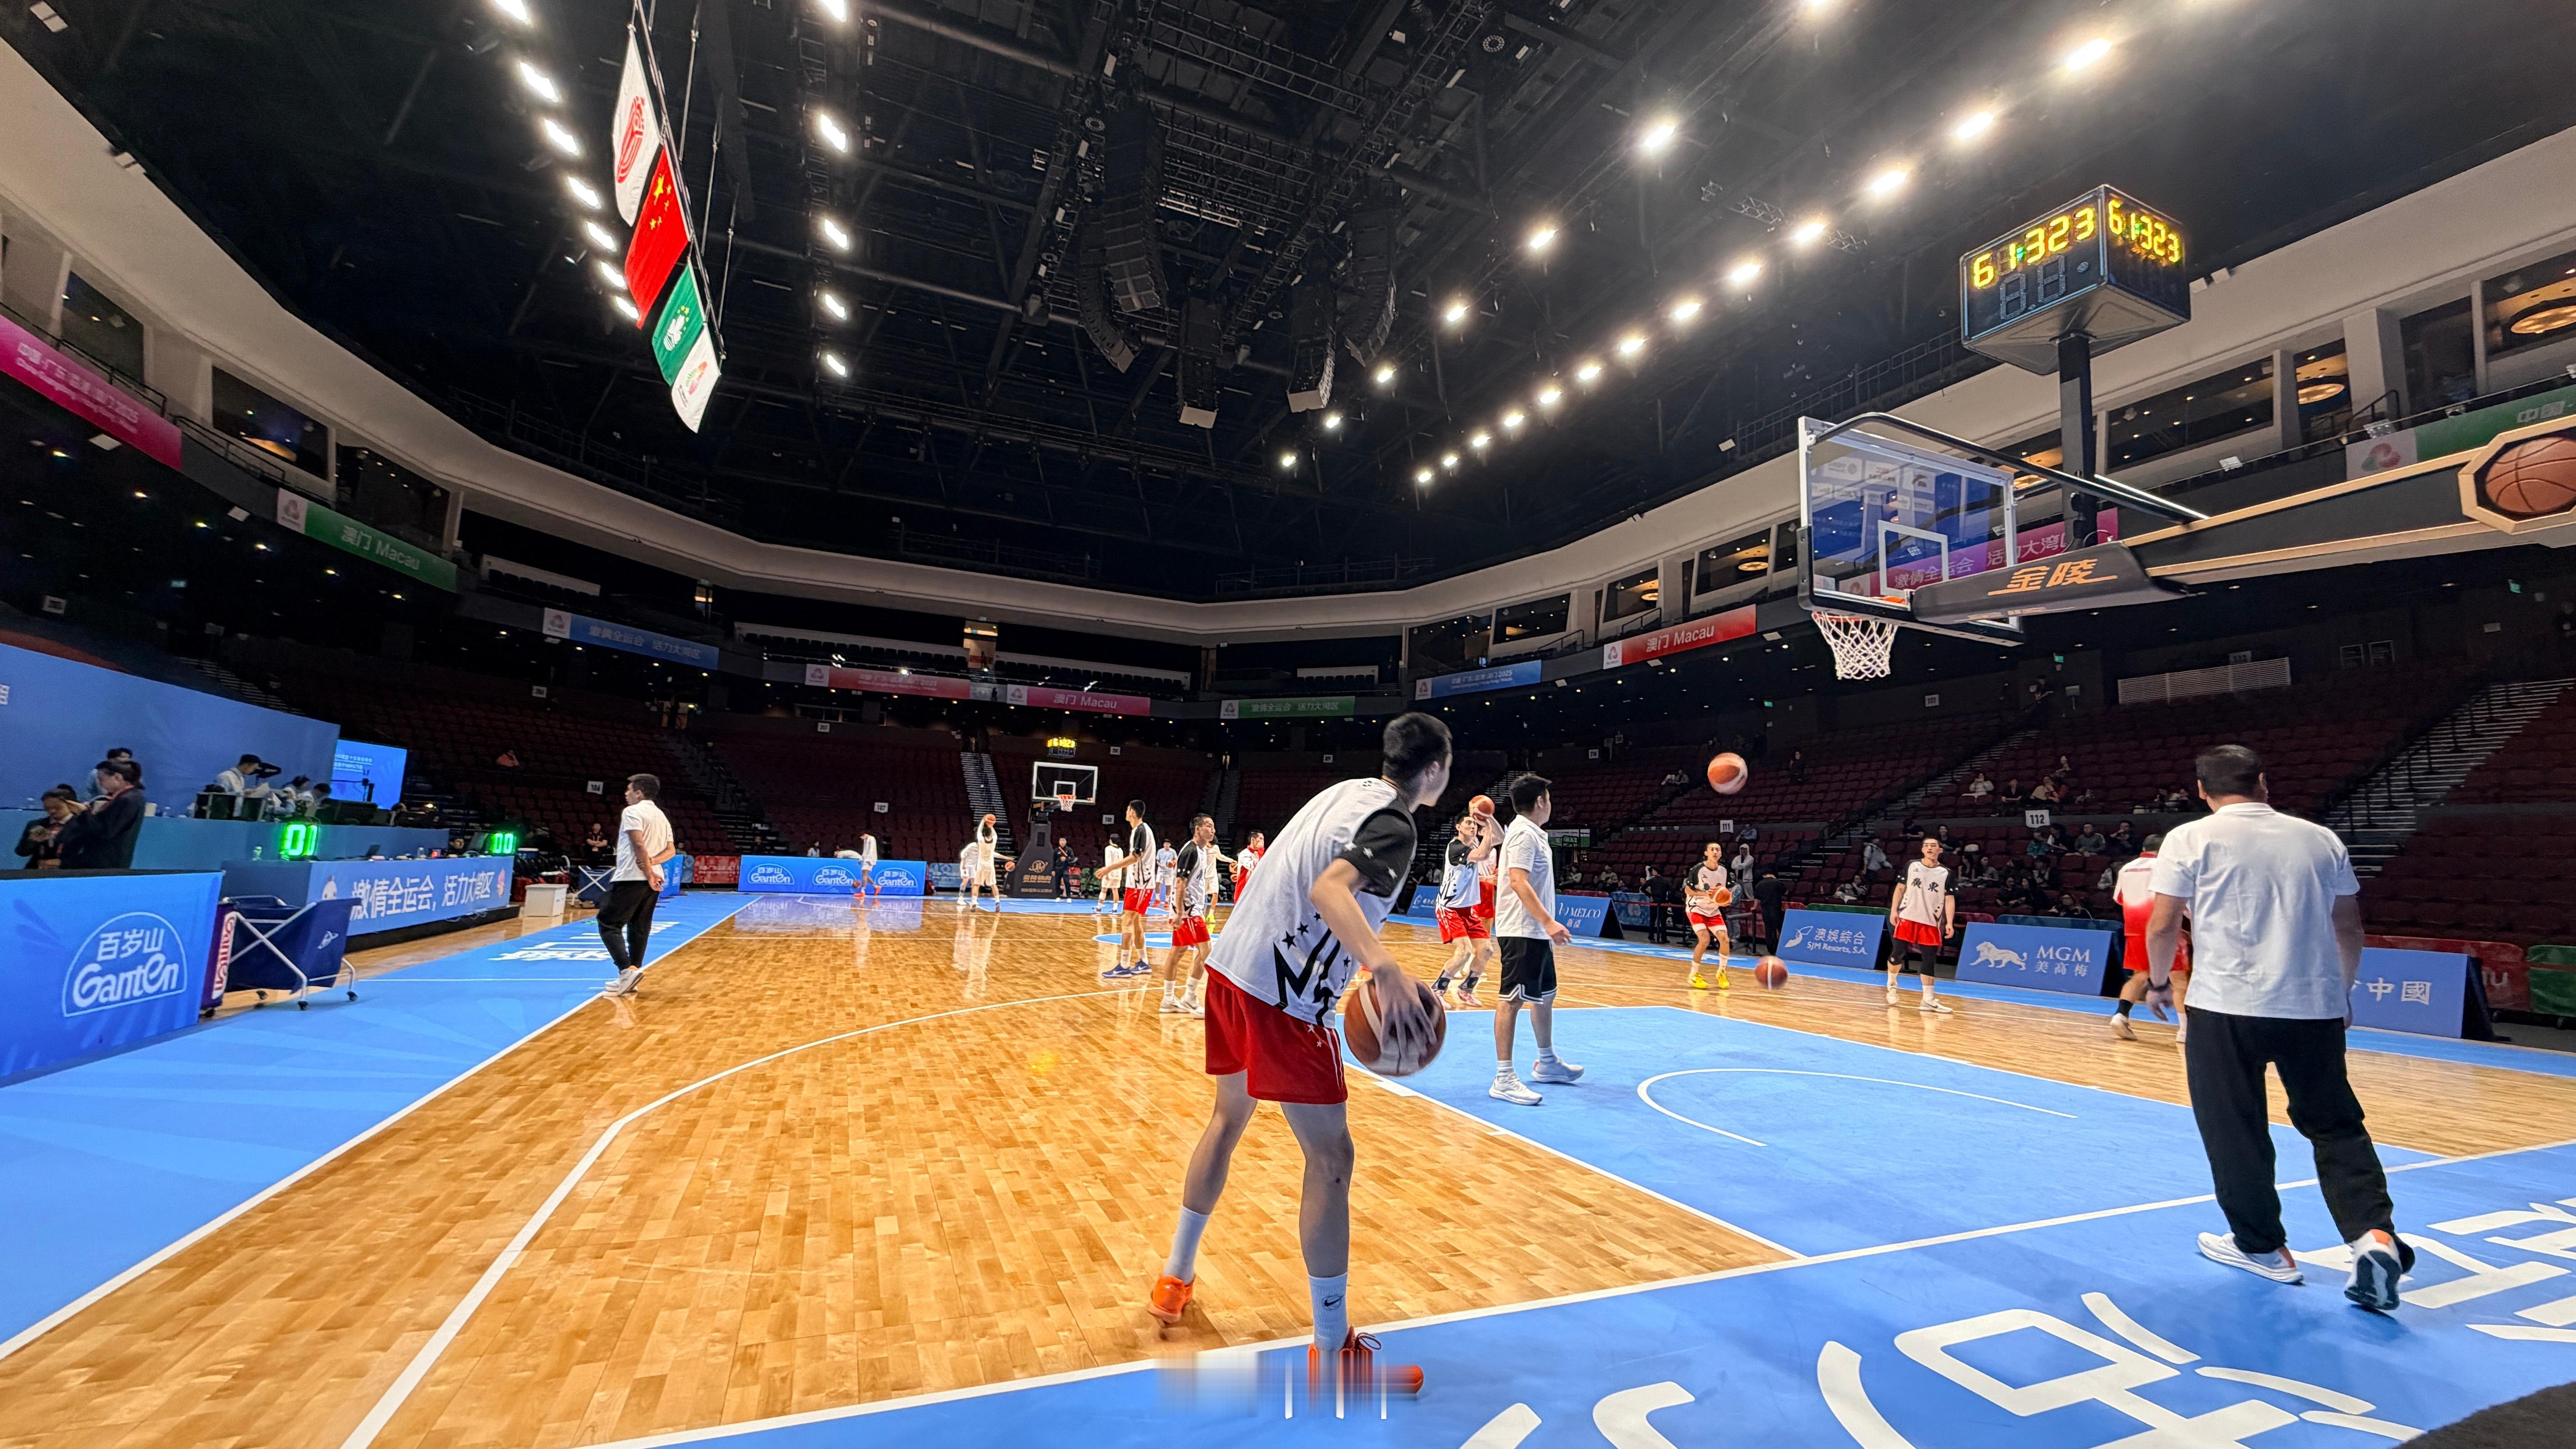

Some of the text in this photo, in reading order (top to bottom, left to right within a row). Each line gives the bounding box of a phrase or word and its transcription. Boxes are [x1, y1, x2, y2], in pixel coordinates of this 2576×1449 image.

[341, 525, 420, 570] 澳门 Macau
[1646, 626, 1714, 652] 澳门 Macau
[1053, 694, 1117, 708] 澳门 Macau
[2030, 814, 2045, 824] 112
[97, 928, 165, 961] 百岁山
[1807, 941, 1822, 951] SJM
[2035, 945, 2090, 962] MGM
[2034, 961, 2088, 977] 美高梅
[73, 953, 179, 1007] Ganten
[2351, 977, 2431, 1005] 中國
